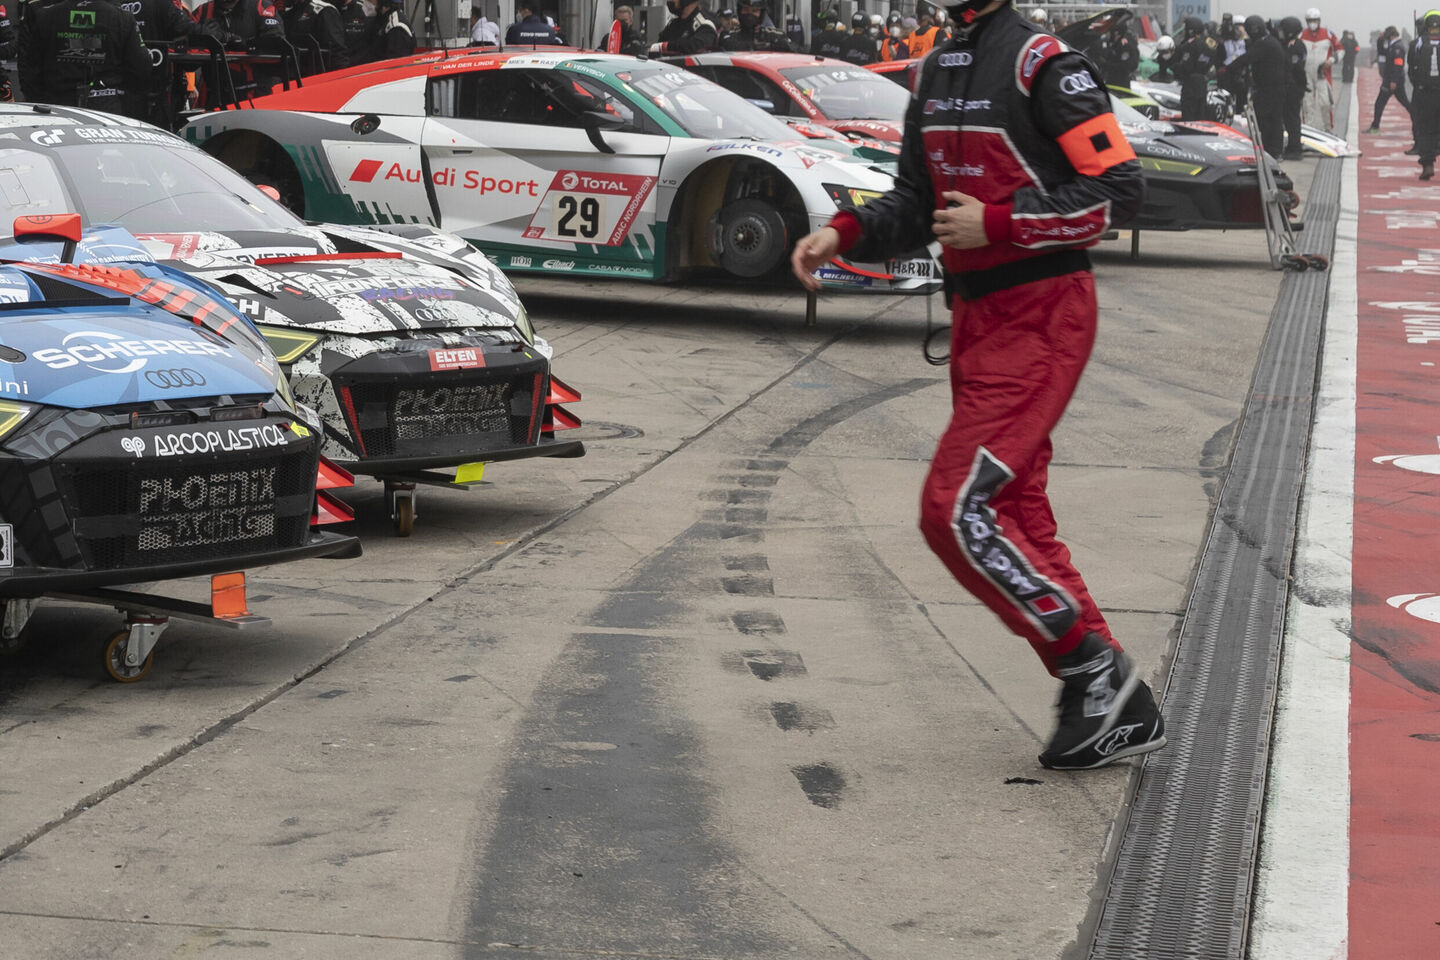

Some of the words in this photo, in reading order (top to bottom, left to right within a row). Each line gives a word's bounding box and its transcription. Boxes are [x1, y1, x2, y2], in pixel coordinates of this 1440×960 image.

[572, 63, 606, 79] VERVISCH
[74, 128, 124, 139] GRAN
[385, 163, 456, 186] Audi
[463, 171, 539, 197] Sport
[581, 177, 628, 191] TOTAL
[558, 196, 600, 238] 29
[612, 222, 628, 245] ADAC
[624, 176, 653, 222] NORDRHEIN
[891, 262, 917, 274] H&R
[823, 272, 866, 283] MICHELIN
[32, 340, 231, 370] SCHERER
[435, 350, 477, 363] ELTEN
[155, 423, 288, 457] ARCOPLASTICA
